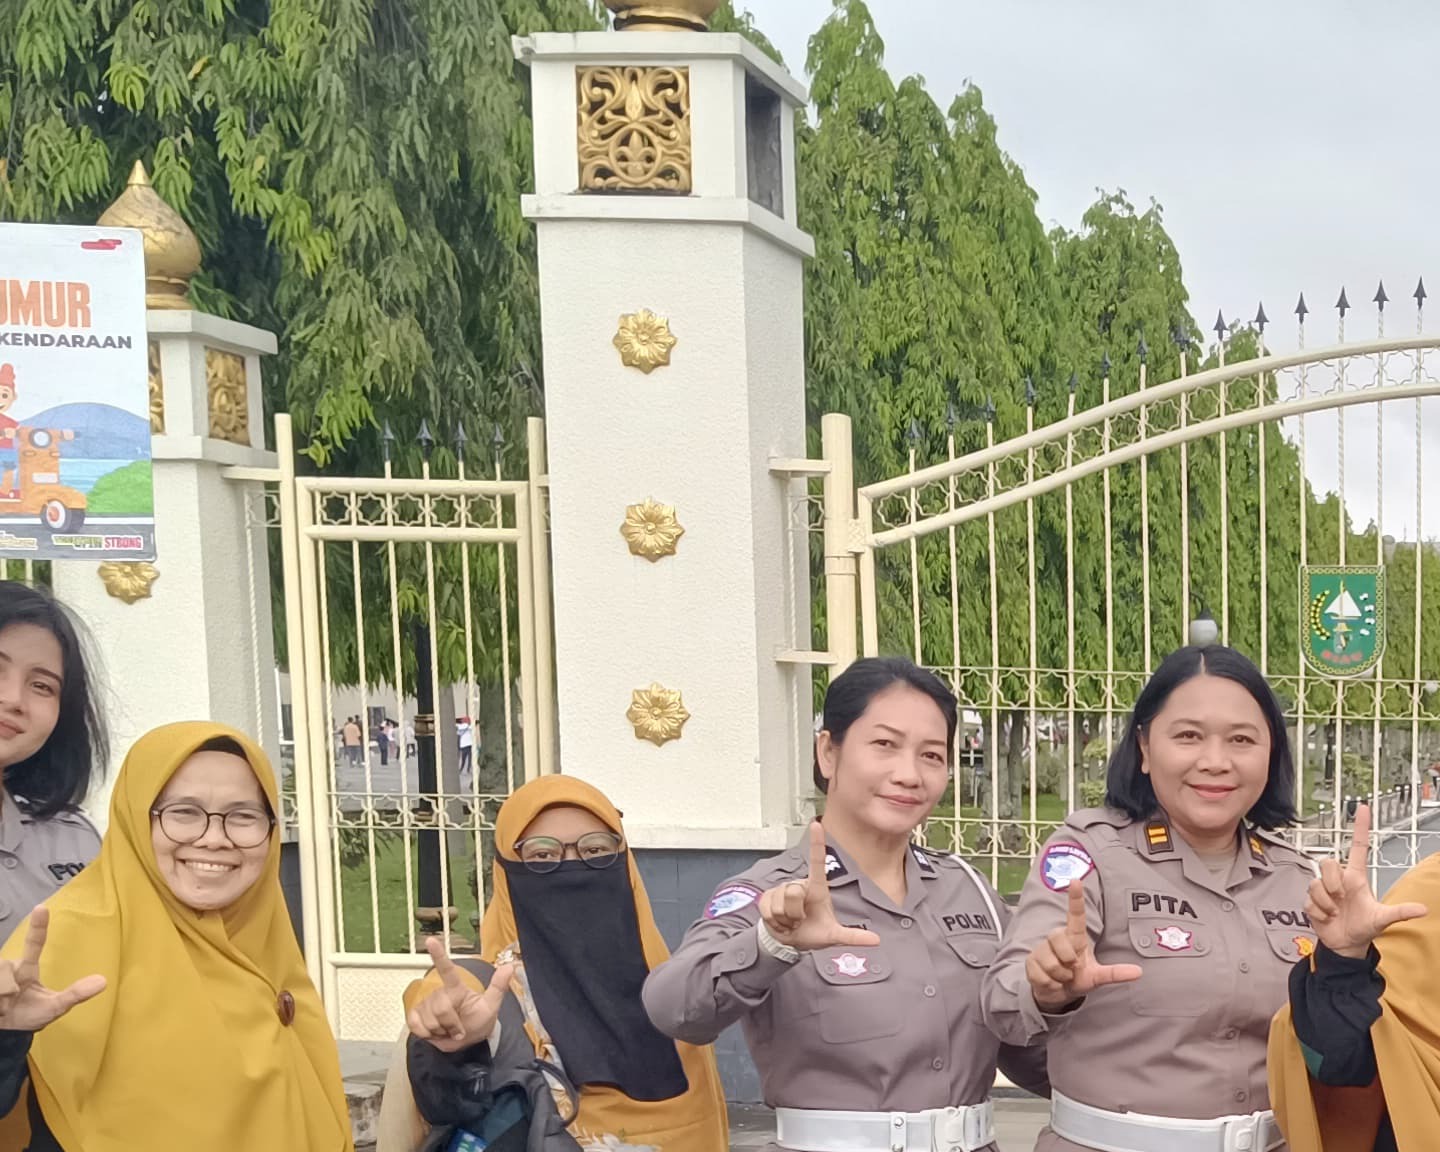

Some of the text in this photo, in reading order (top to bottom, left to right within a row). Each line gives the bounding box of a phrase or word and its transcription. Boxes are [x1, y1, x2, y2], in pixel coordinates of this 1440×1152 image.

[1131, 892, 1198, 919] PITA
[942, 913, 992, 931] POLRI
[1262, 909, 1311, 928] POL
